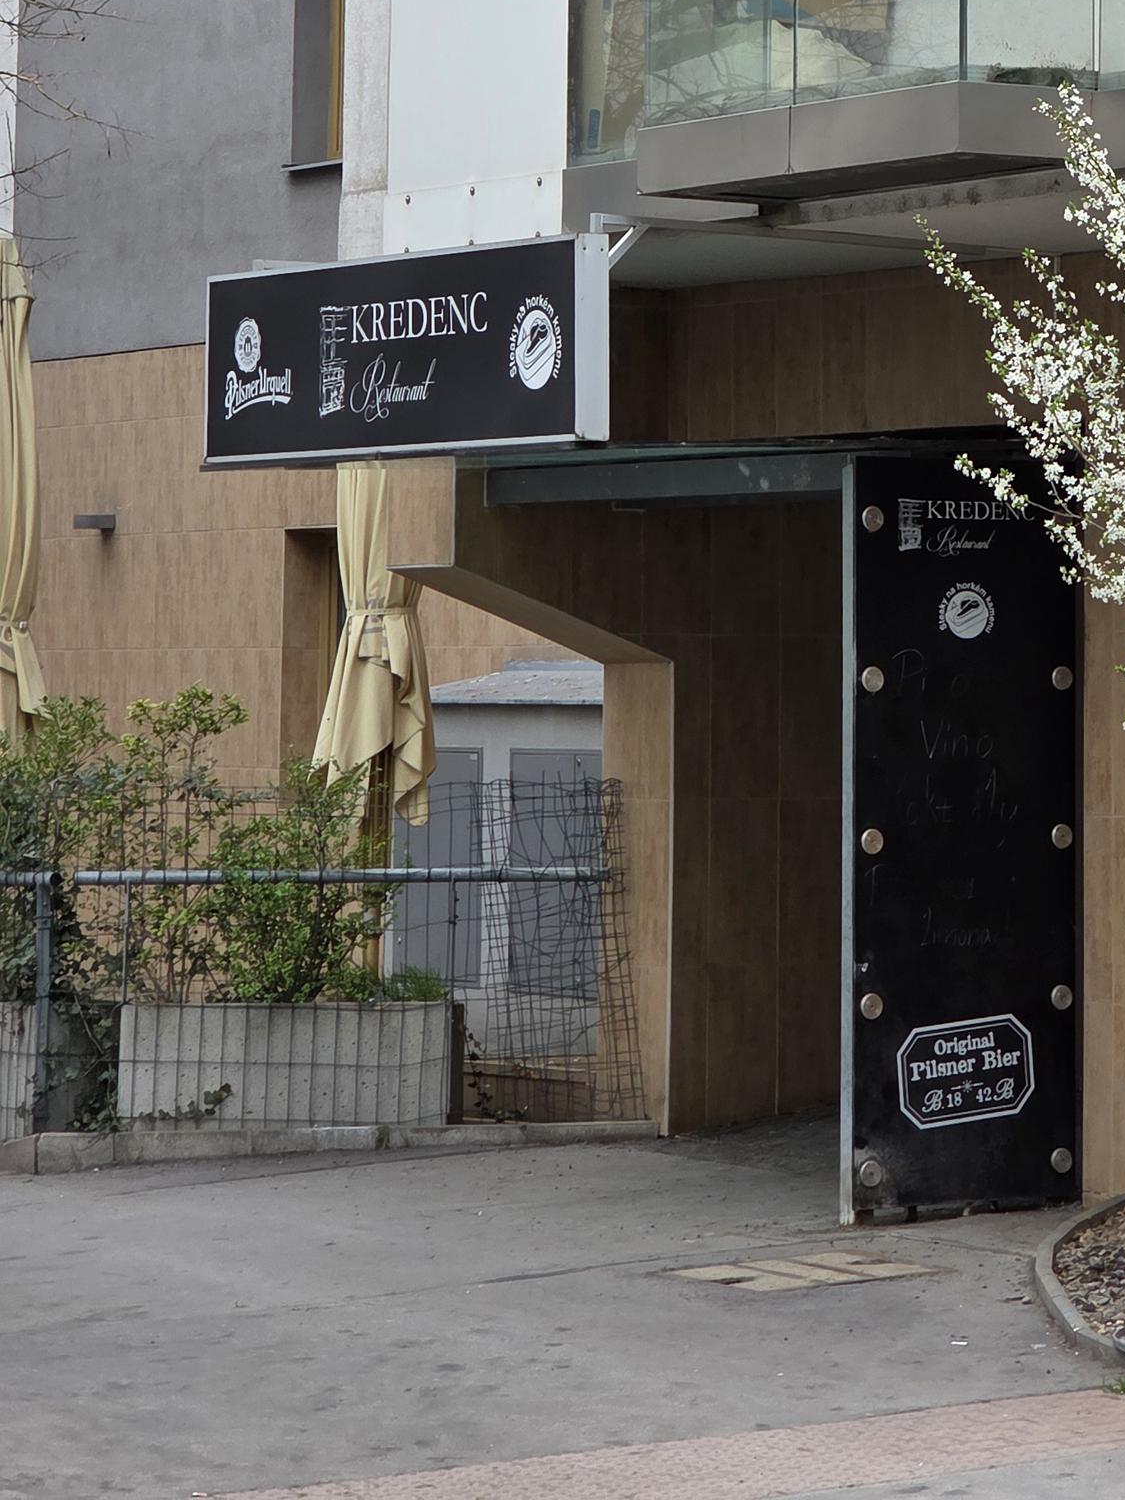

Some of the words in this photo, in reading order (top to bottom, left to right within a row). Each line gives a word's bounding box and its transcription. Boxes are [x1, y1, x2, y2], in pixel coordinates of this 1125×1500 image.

[350, 291, 489, 345] KREDENC
[224, 370, 261, 421] Pilsner
[258, 365, 292, 406] Urquell
[349, 352, 438, 423] Restaurant
[909, 1057, 977, 1082] Pilsner
[981, 1048, 1021, 1071] Bier
[933, 1031, 996, 1056] Original
